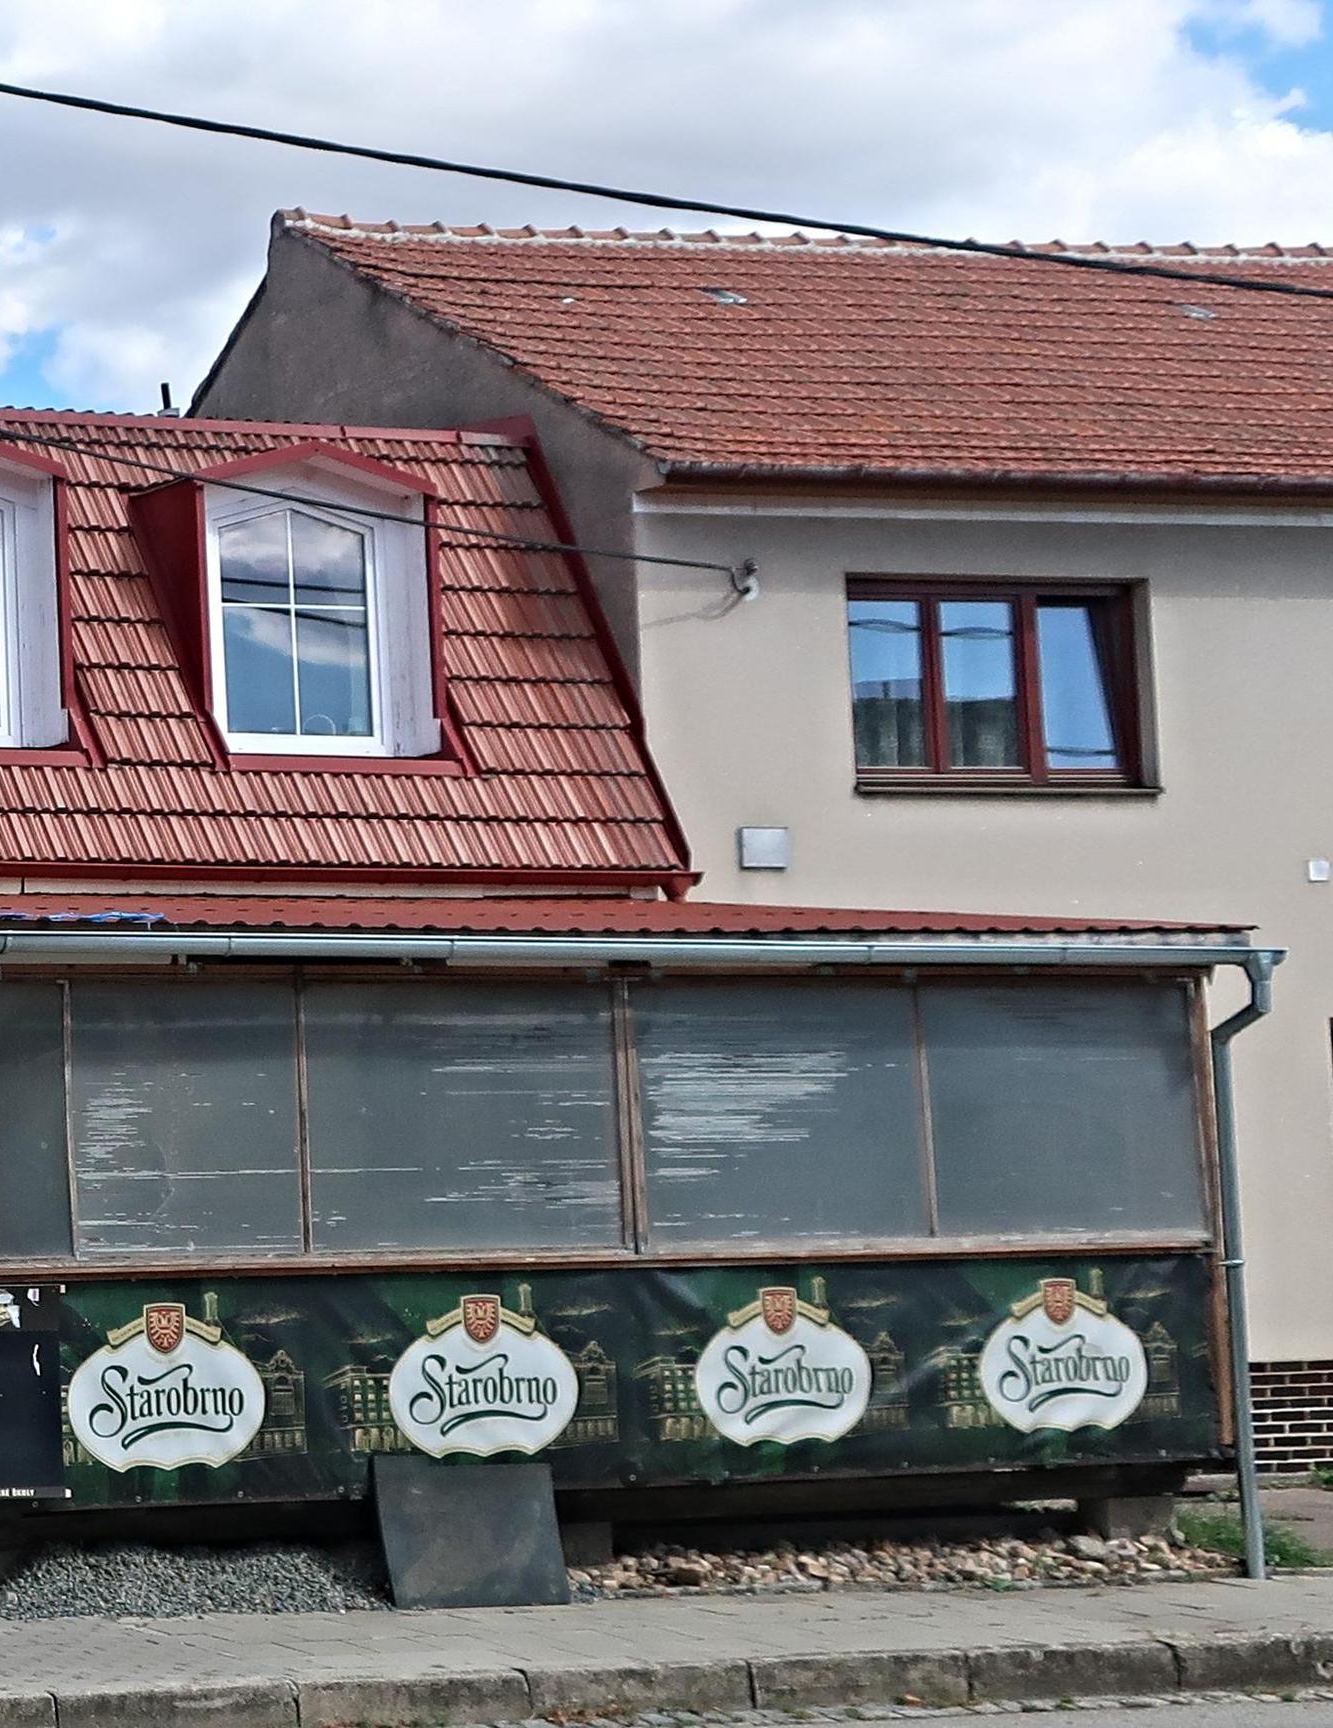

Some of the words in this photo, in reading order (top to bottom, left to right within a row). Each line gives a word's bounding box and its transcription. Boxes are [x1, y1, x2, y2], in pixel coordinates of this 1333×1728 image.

[89, 1363, 244, 1450] Starobrno
[409, 1353, 558, 1437] Starobrno
[717, 1344, 854, 1425] Starobrno
[999, 1334, 1130, 1413] Starobrno
